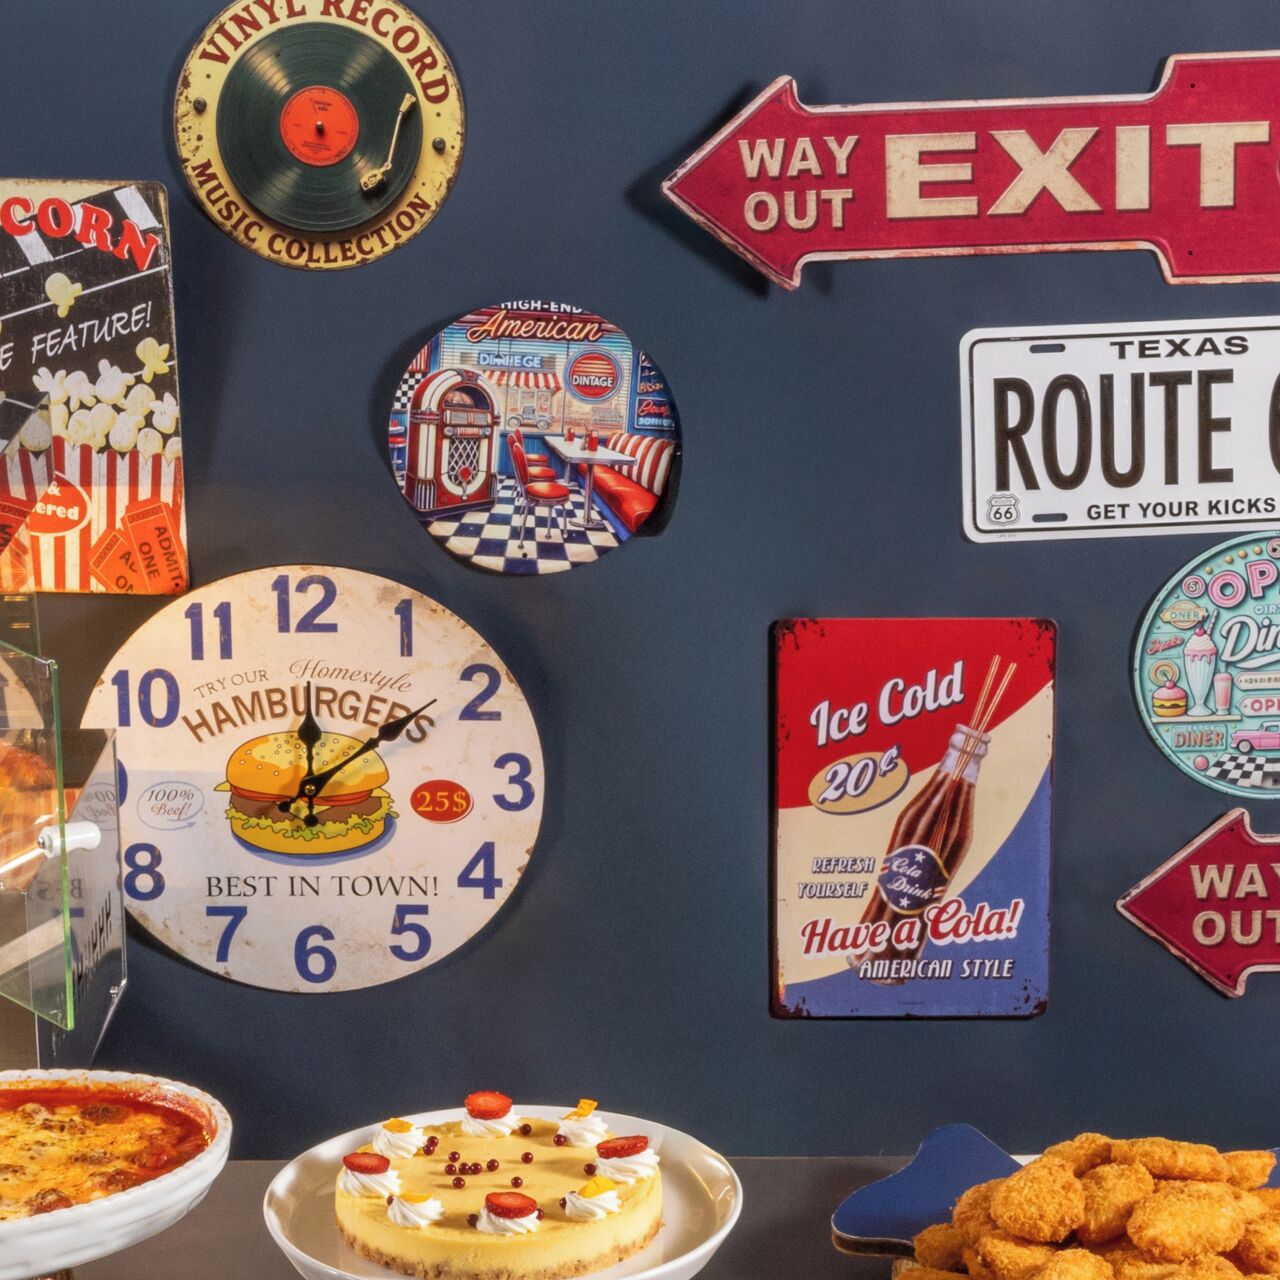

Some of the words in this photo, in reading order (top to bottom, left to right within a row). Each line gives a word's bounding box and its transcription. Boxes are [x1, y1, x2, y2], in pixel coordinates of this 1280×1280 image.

[199, 0, 307, 65] VINYL
[320, 0, 451, 104] RECORD
[738, 135, 859, 178] WAY
[884, 121, 1270, 220] EXIT
[191, 158, 265, 244] MUSIC
[267, 193, 432, 265] COLLECTION
[744, 188, 853, 232] OUT
[32, 301, 153, 364] FEATURE!
[467, 311, 601, 342] American
[1110, 336, 1250, 360] TEXAS
[993, 368, 1234, 492] ROUTE
[1087, 503, 1130, 521] GET
[1137, 500, 1200, 519] YOUR
[1208, 497, 1276, 516] KICKS
[184, 601, 232, 660] 11
[271, 574, 338, 634] 12
[394, 599, 413, 657] 1
[111, 668, 180, 728] 10
[194, 678, 228, 700] TRY
[230, 669, 270, 687] OUR
[289, 658, 412, 694] Homestyle
[458, 663, 502, 721] 2
[810, 700, 868, 746] Ice
[878, 661, 965, 727] Cold
[181, 686, 436, 745] HAMBURGERS
[1173, 731, 1224, 748] DINER
[416, 790, 468, 813] 25$
[493, 753, 535, 812] 3
[124, 843, 165, 901] 8
[206, 876, 277, 898] BEST
[288, 876, 320, 897] IN
[341, 875, 440, 897] TOWN!
[457, 841, 503, 900] 4
[797, 882, 869, 899] YOURSELF
[811, 857, 874, 874] REFRESH
[887, 874, 933, 900] Drink
[891, 857, 921, 879] Cola
[206, 906, 247, 963] 7
[294, 925, 337, 984] 6
[389, 904, 432, 962] 5
[800, 917, 887, 957] Have
[892, 922, 919, 949] a
[926, 898, 1024, 944] Cola!
[859, 960, 952, 980] AMERICAN
[960, 958, 1014, 979] STYLE
